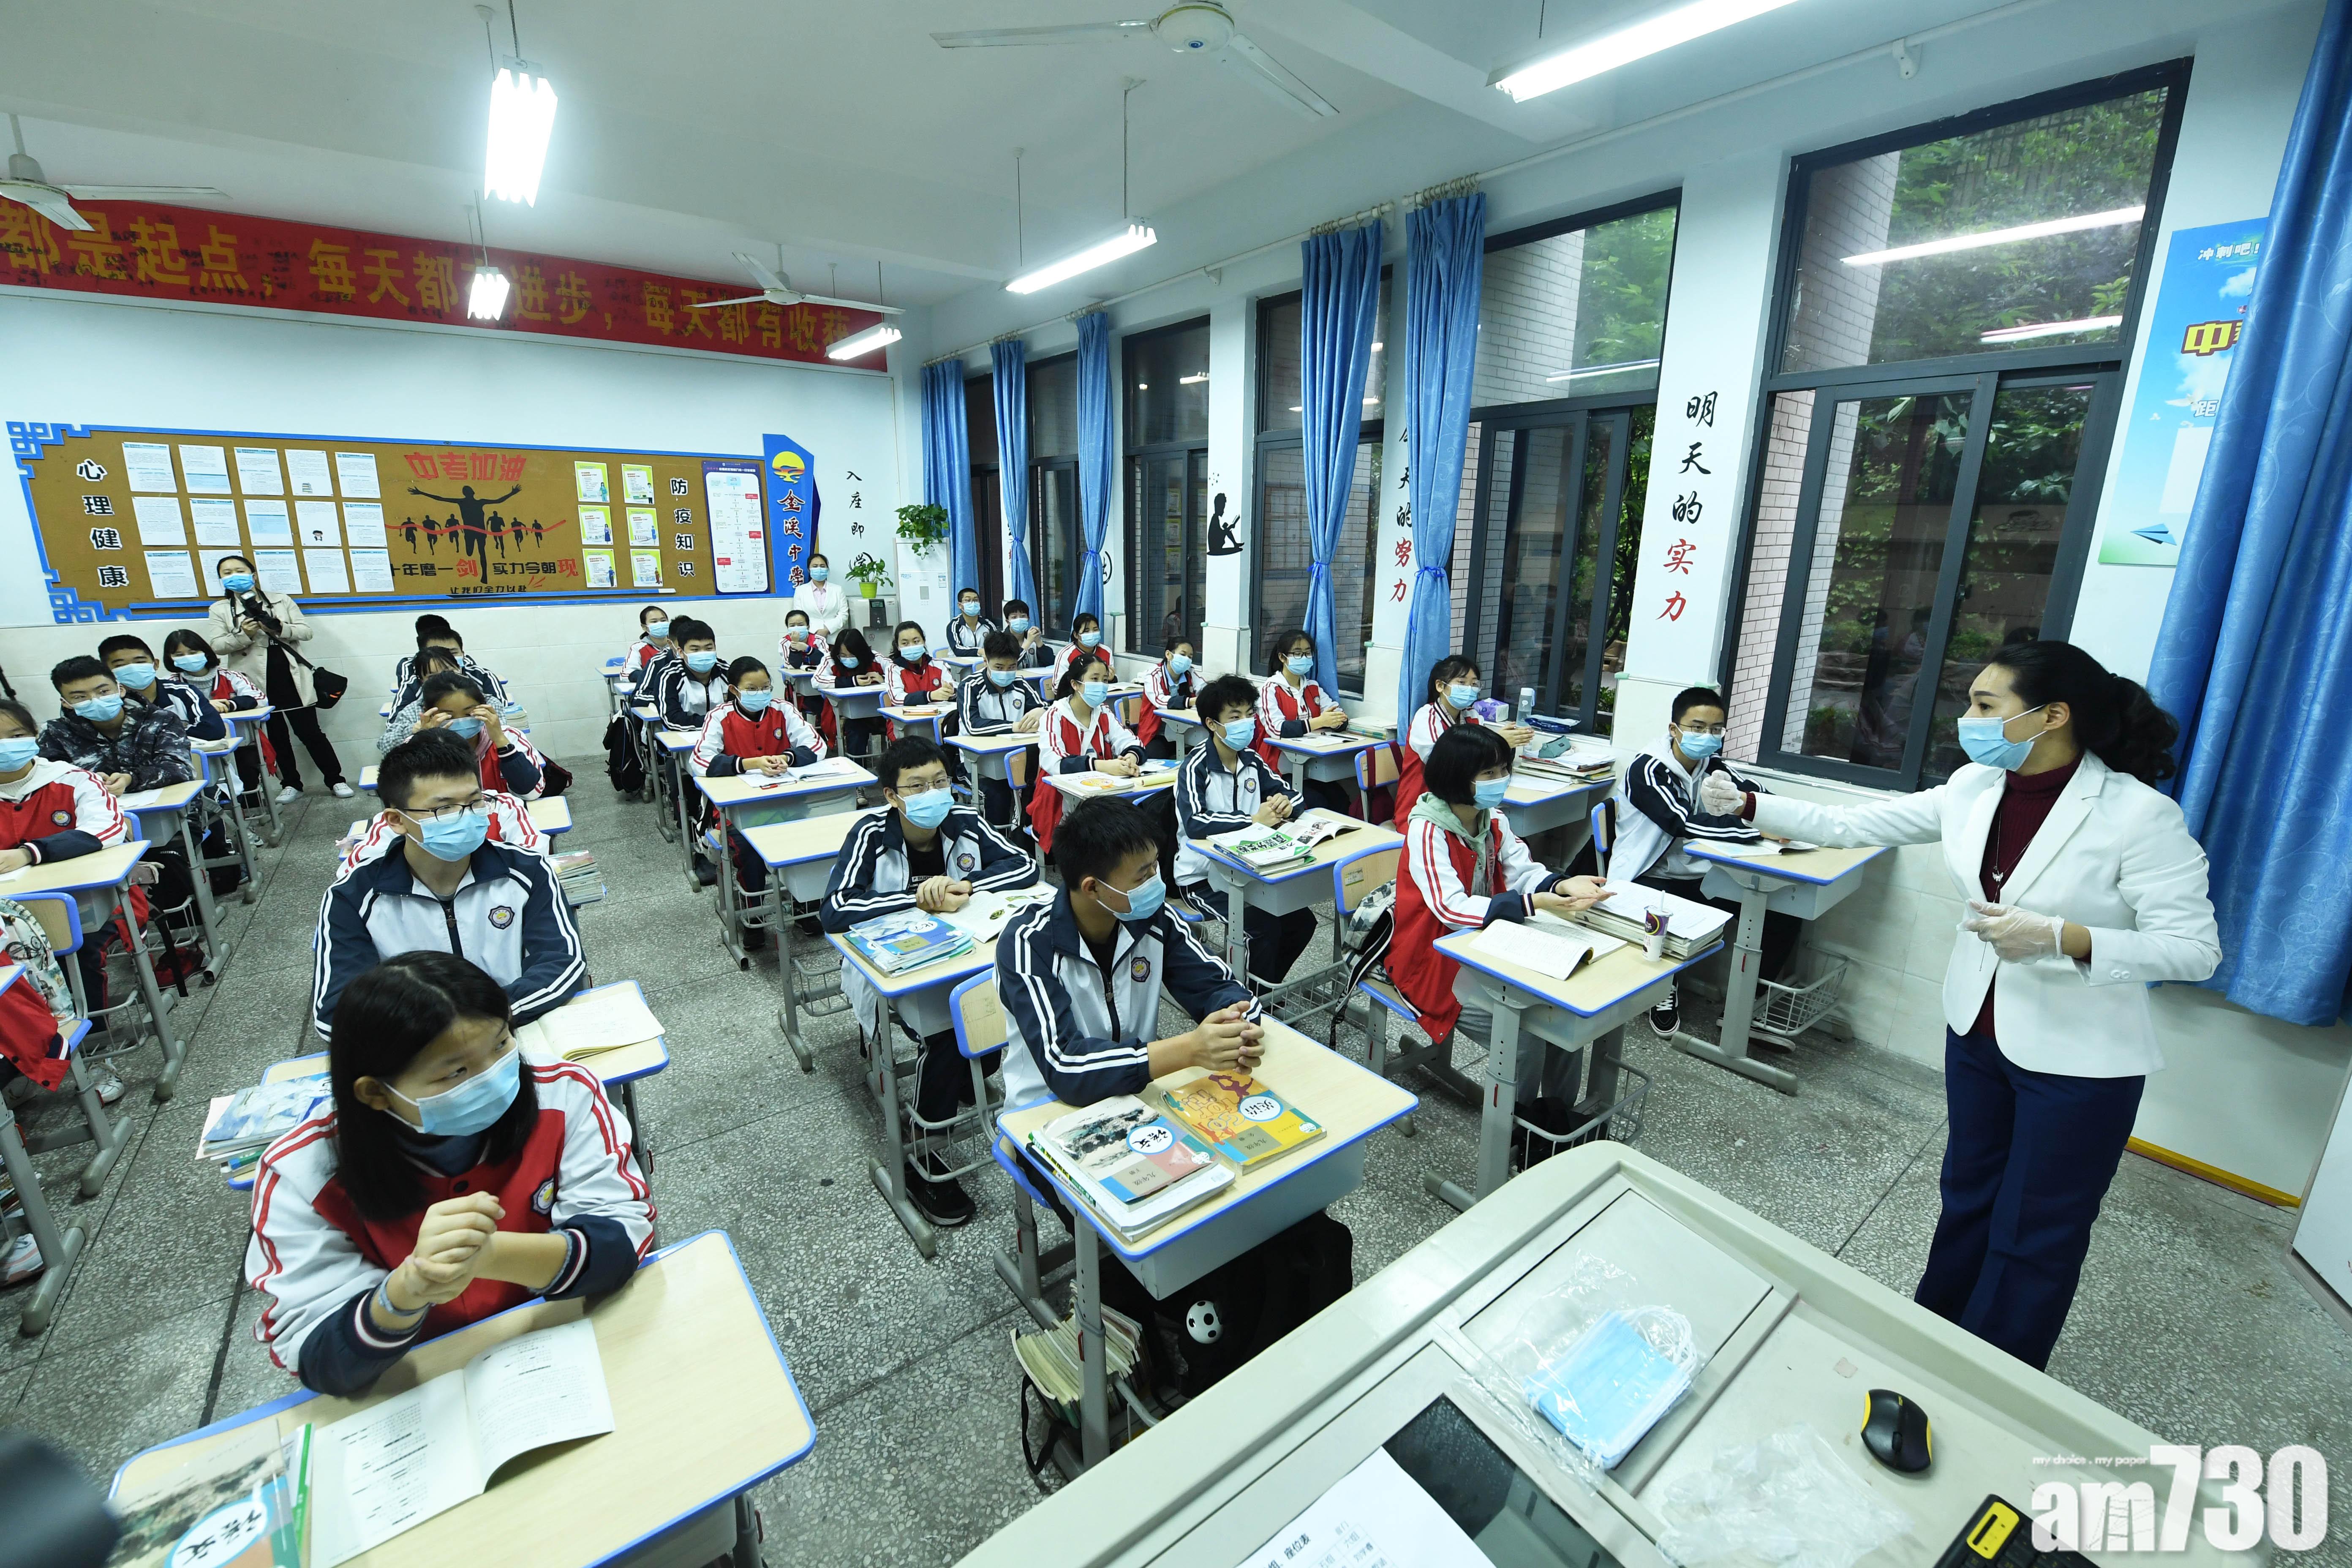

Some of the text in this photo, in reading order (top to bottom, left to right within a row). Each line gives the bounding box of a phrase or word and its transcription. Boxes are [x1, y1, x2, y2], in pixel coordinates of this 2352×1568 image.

[2198, 242, 2259, 260] 冲刺吧！
[404, 452, 527, 481] 中考加油
[1656, 391, 1718, 621] 明天的实力
[78, 459, 128, 586] 心理健康
[671, 478, 695, 577] 防疫知识
[492, 558, 579, 578] 实力今朝现
[450, 585, 526, 594] 让我们全力以赴
[1245, 1099, 1274, 1117] 英语
[1132, 1130, 1168, 1149] 语文
[178, 1510, 261, 1565] 语文
